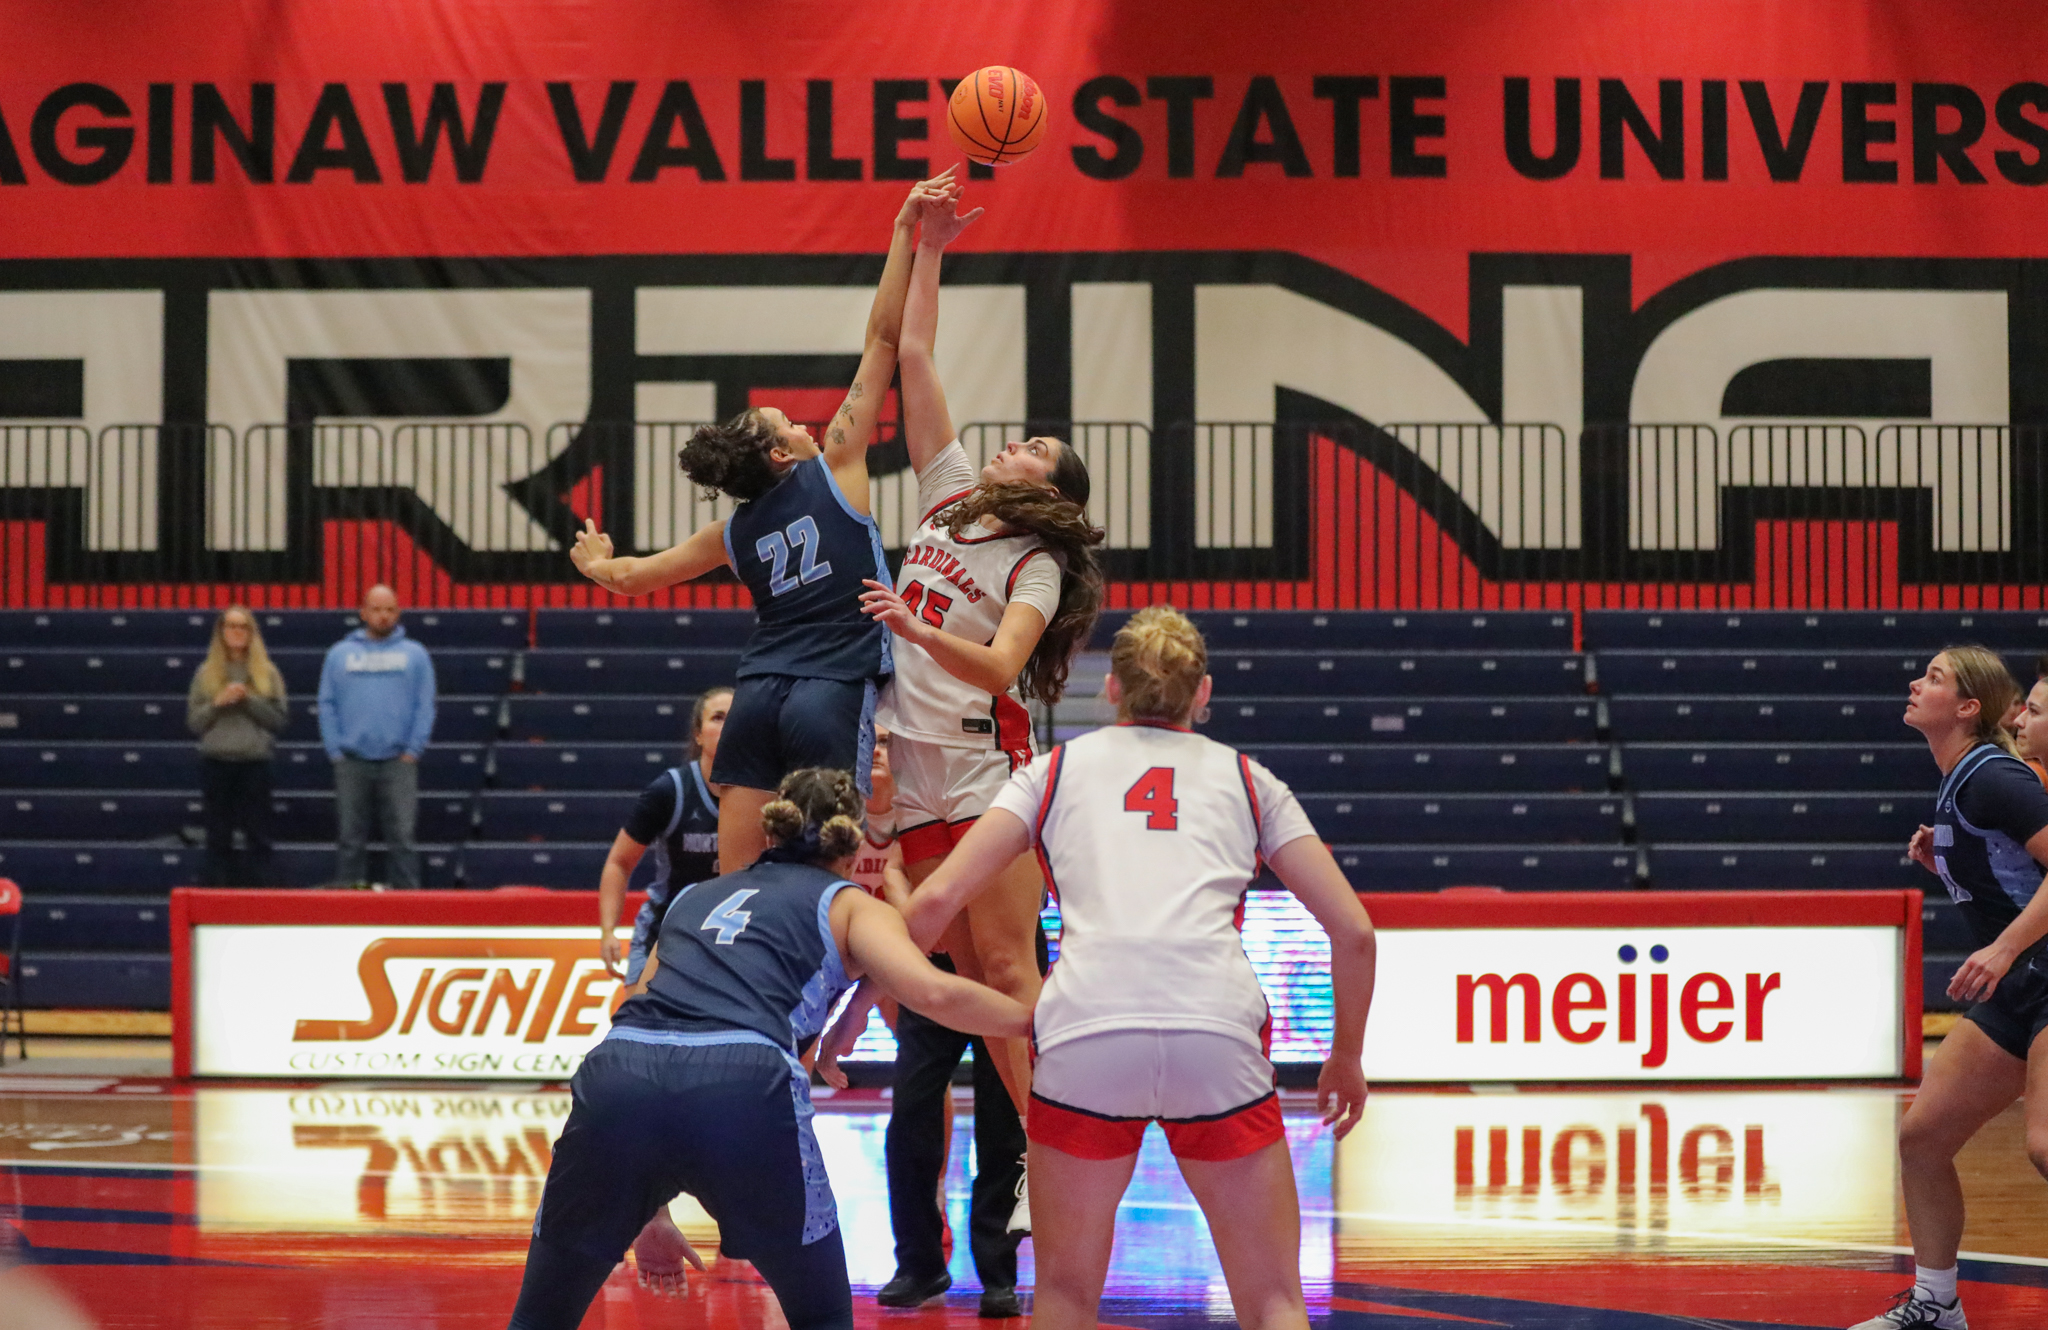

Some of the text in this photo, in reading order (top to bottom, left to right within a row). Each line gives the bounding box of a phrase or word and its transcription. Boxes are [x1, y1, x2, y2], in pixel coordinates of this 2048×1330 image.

[1071, 74, 1447, 181] STATE
[1503, 77, 2048, 187] UNIVERS
[755, 514, 833, 598] 22
[899, 578, 954, 630] 45
[1123, 766, 1179, 832] 4
[700, 888, 760, 946] 4
[1456, 944, 1781, 1068] meijer
[288, 1052, 421, 1072] CUSTOM
[433, 1053, 504, 1072] SIGN
